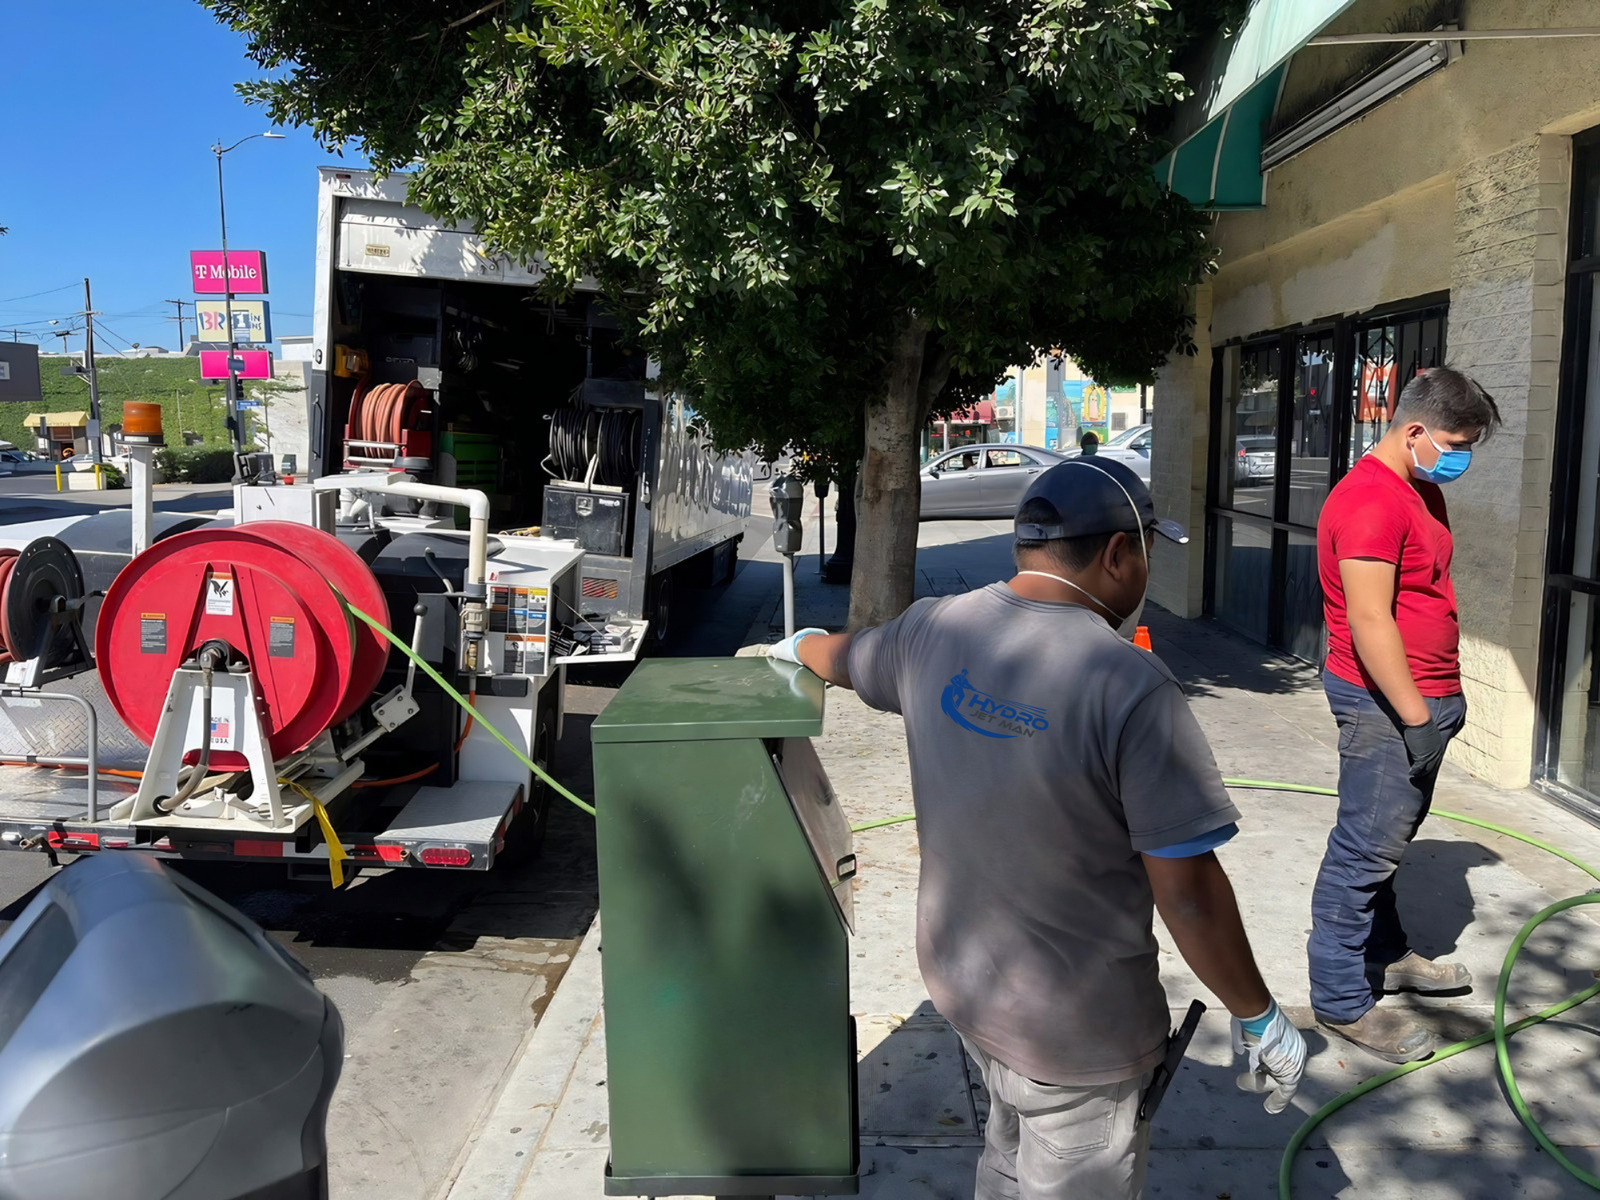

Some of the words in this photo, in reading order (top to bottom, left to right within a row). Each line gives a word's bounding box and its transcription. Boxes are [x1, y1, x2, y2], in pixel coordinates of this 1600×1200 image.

[195, 264, 207, 279] T
[968, 694, 1049, 731] HYDRO
[969, 710, 997, 723] JET
[998, 720, 1035, 738] MAN
